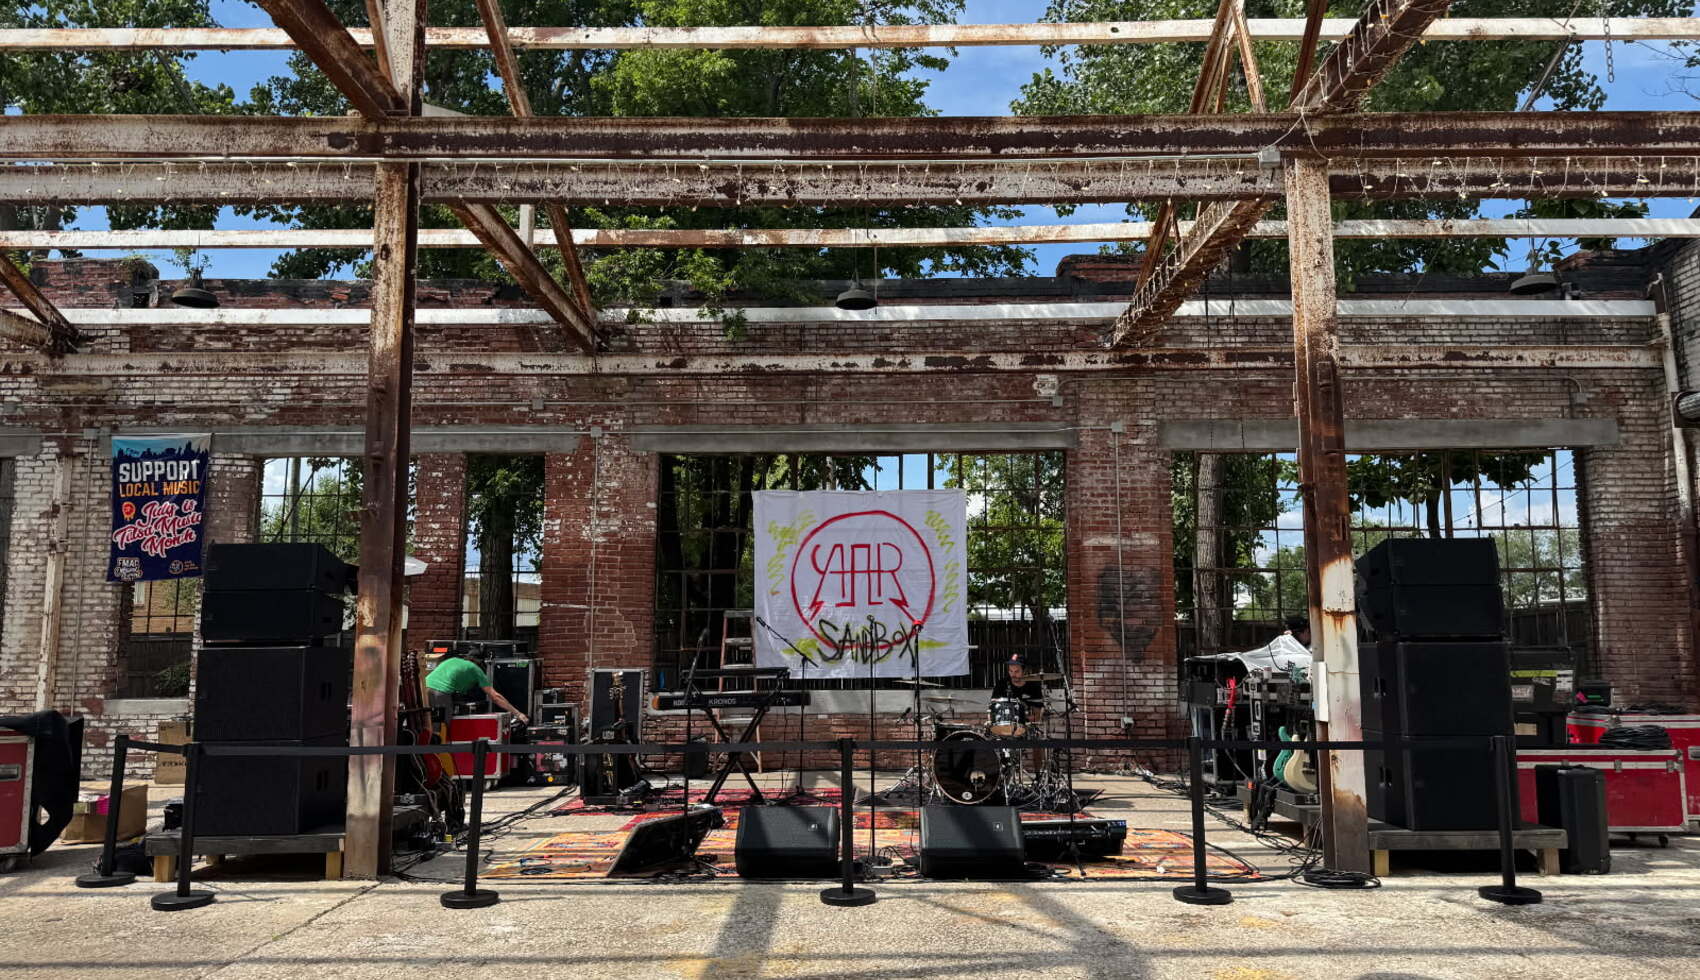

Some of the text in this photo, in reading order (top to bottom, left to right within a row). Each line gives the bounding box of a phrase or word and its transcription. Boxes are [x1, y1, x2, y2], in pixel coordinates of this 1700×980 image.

[119, 460, 200, 483] SUPPORT
[119, 480, 200, 498] LOCAL MUSIC
[137, 501, 179, 527] July
[182, 499, 197, 512] is
[112, 512, 202, 550] Tulsa Music
[817, 618, 917, 667] SANDBOX
[708, 698, 737, 706] KRONOS
